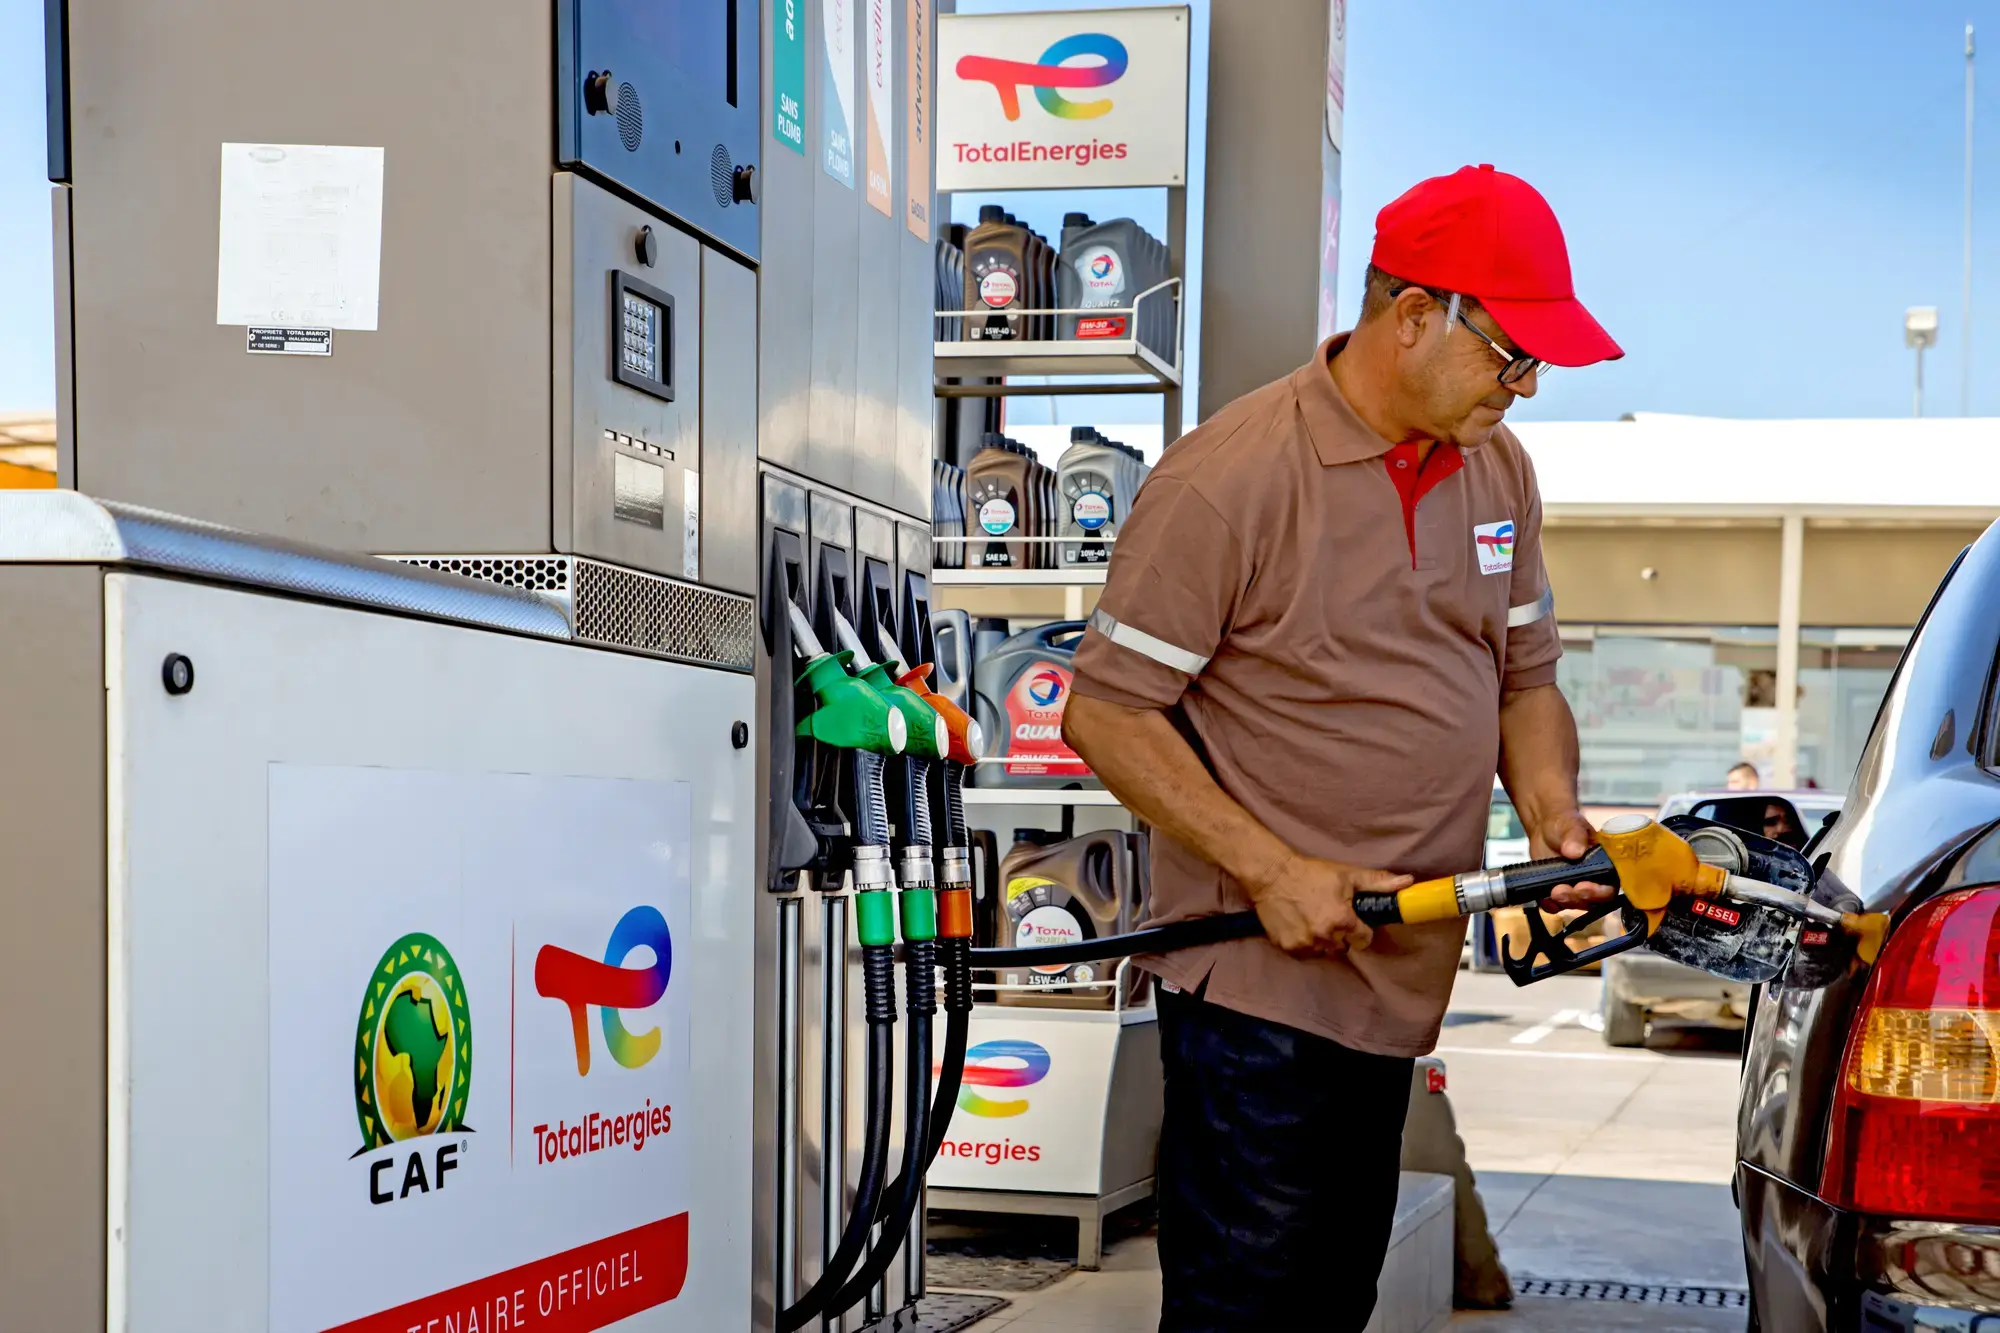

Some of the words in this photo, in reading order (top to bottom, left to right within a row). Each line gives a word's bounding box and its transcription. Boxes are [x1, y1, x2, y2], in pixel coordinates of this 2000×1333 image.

[781, 93, 798, 120] SANS
[778, 114, 801, 144] PLOMB
[831, 130, 846, 154] SANS
[828, 150, 849, 178] PLOMB
[953, 139, 1128, 166] TotalEnergies
[1085, 300, 1119, 308] QUARTZ
[1026, 710, 1063, 719] TOTA
[1036, 926, 1075, 936] TOTAL
[1028, 976, 1068, 985] 15W-40
[533, 1098, 671, 1165] TotalEnergies
[370, 1143, 458, 1205] CAF
[407, 1288, 525, 1333] NAIRE
[539, 1250, 643, 1317] OFFICIEL
